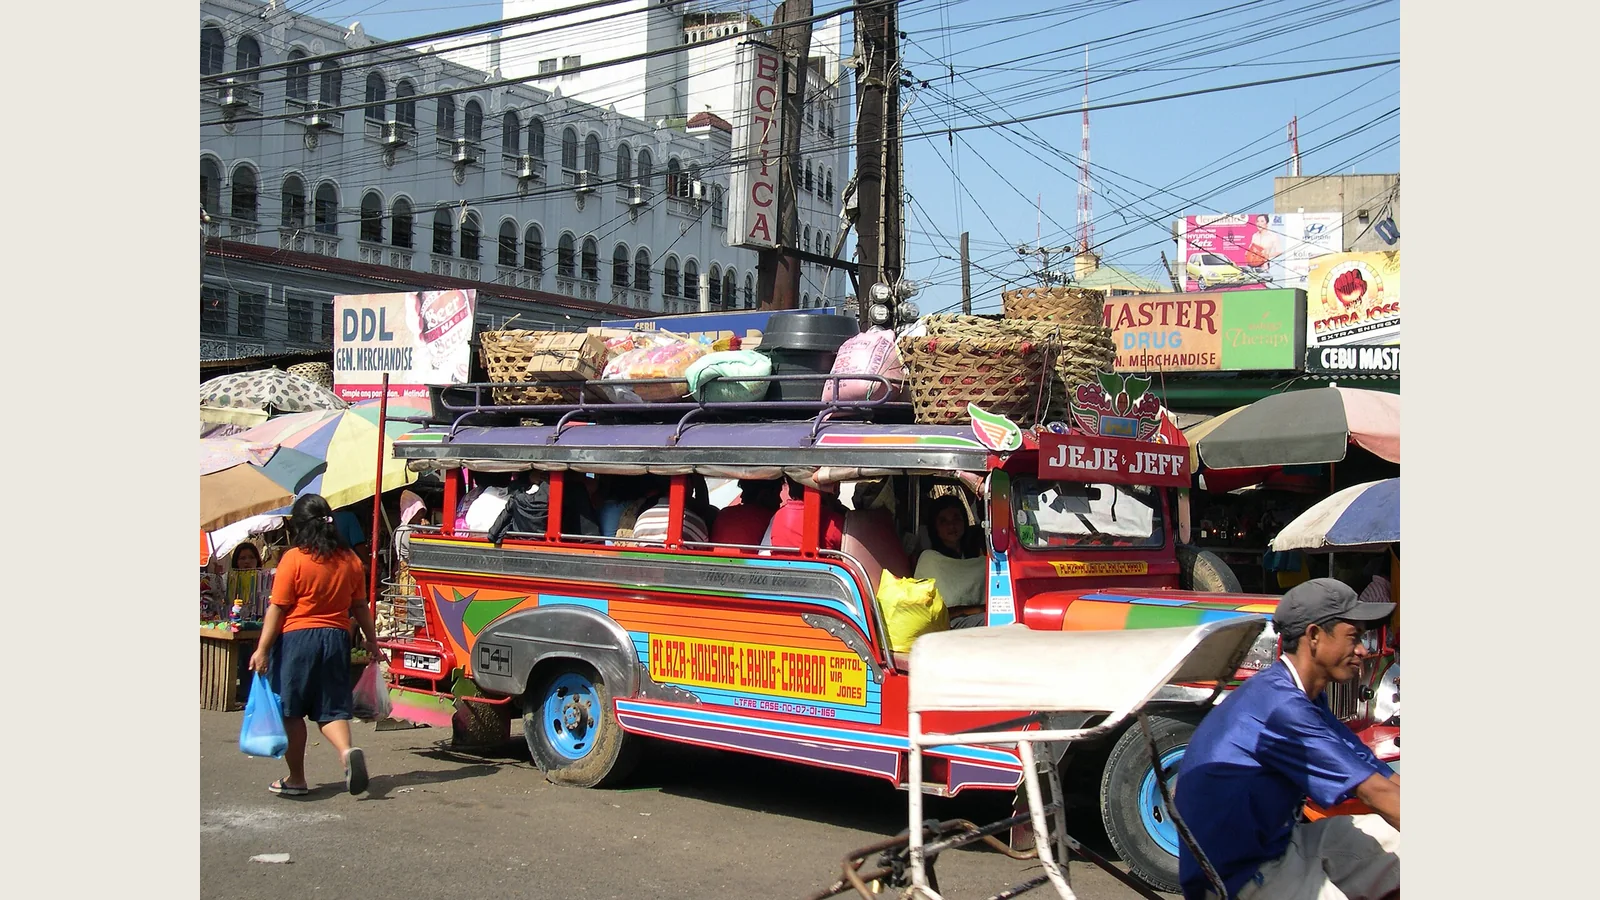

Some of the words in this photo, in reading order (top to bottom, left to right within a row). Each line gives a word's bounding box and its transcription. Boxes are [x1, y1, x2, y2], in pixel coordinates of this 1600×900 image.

[749, 53, 779, 242] BOTICA
[342, 306, 394, 342] DDL
[1314, 311, 1360, 334] EXTRA
[1364, 302, 1400, 323] JOSS
[1123, 331, 1183, 350] DRUG
[1224, 328, 1290, 349] Therapy
[1320, 329, 1354, 341] EXTRA
[1357, 319, 1399, 333] ENERGY
[336, 347, 356, 371] GEN.
[356, 347, 413, 371] MERCHANDISE
[1129, 352, 1216, 367] MERCHANDISE
[1321, 347, 1357, 369] CEBU
[1359, 347, 1400, 371] MAST
[1048, 444, 1119, 472] JEJE
[1128, 452, 1184, 476] JEFF
[652, 638, 686, 678] PLAZA
[690, 642, 735, 685] HOUSING
[739, 647, 776, 690] LAHUG
[781, 652, 826, 696] CARBON
[829, 656, 862, 672] CAPITOL
[829, 671, 843, 683] VIA
[836, 685, 862, 699] JONES
